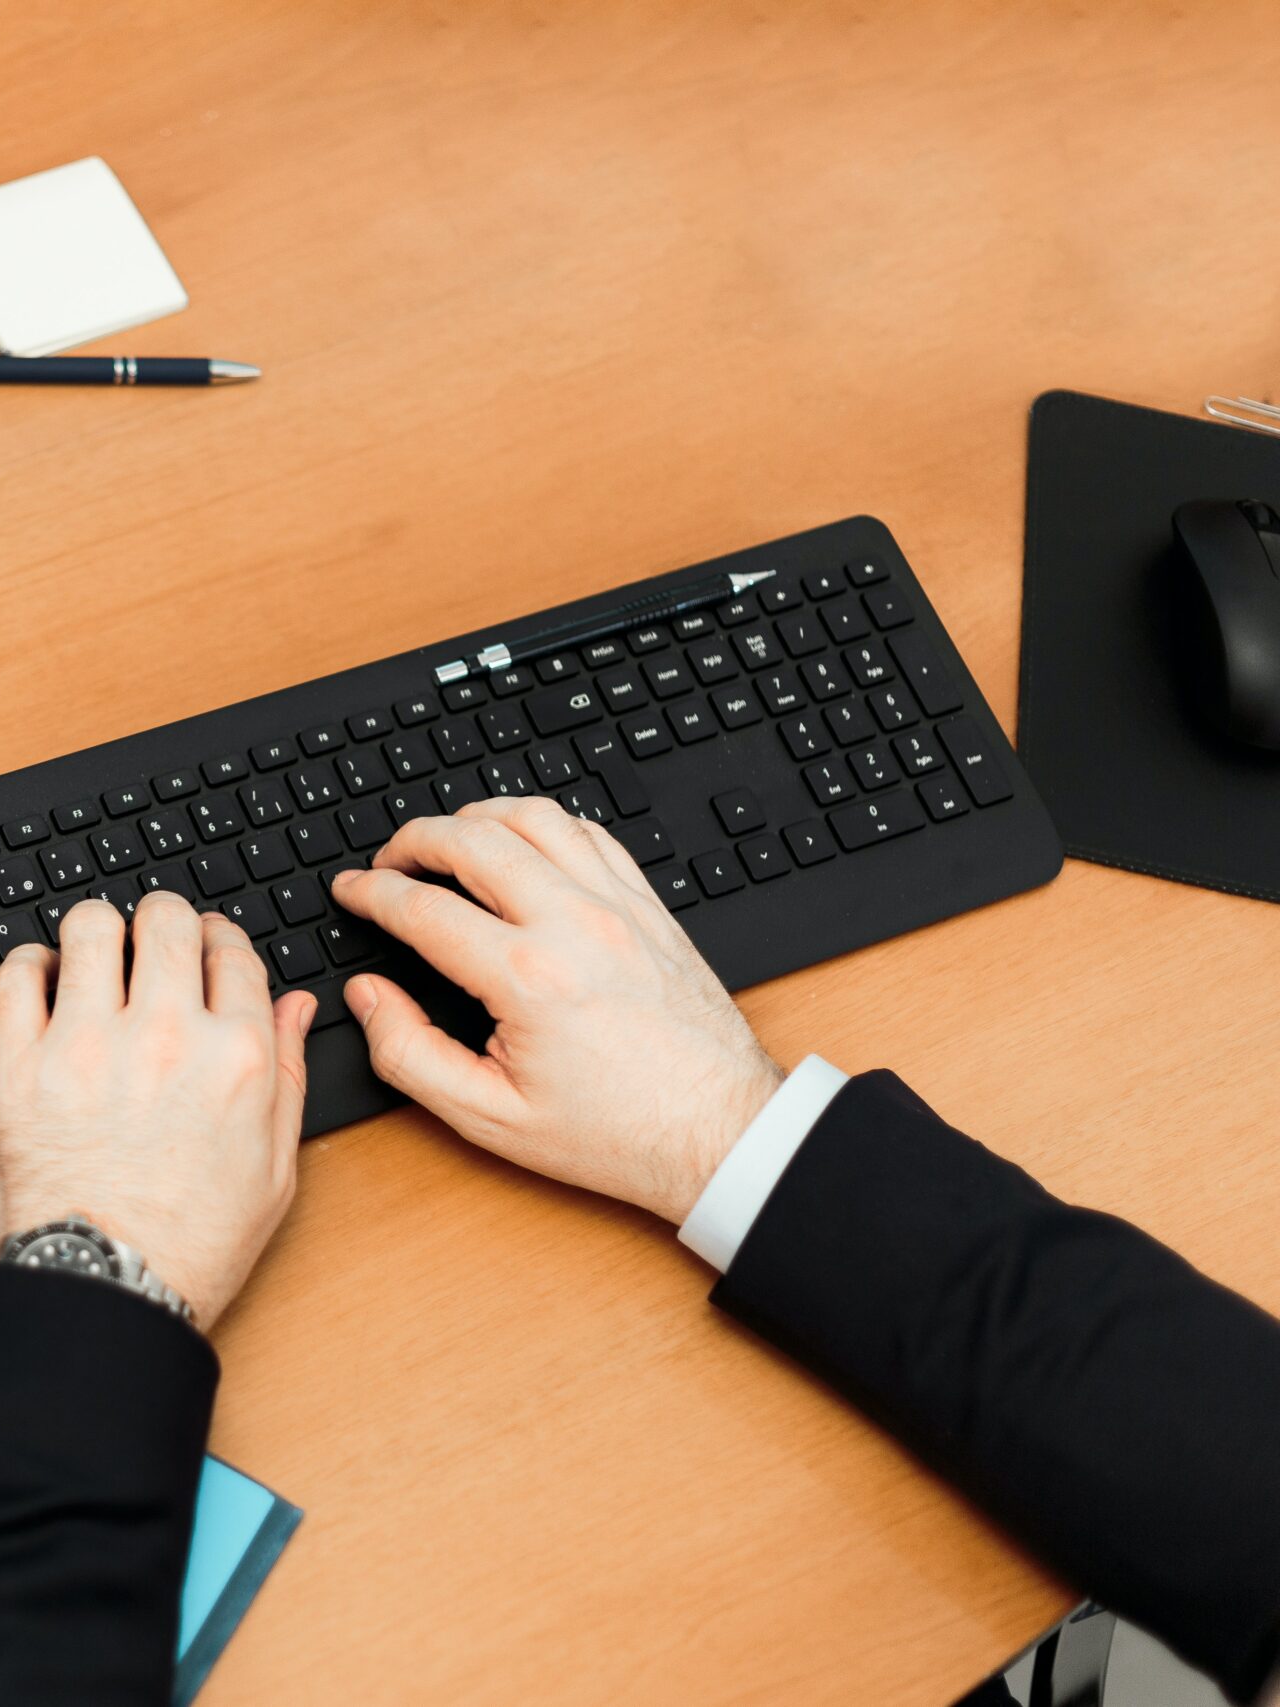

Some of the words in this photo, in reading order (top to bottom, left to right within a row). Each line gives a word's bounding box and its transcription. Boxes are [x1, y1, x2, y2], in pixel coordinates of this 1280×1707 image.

[683, 618, 703, 629] Pause
[592, 646, 614, 658] PrtScn
[862, 650, 870, 661] 9
[703, 655, 722, 667] PgUp
[818, 664, 826, 675] 8
[506, 674, 518, 684] F12
[658, 669, 678, 680] Home
[773, 678, 780, 689] 7
[460, 689, 471, 698] F11
[612, 683, 632, 695] Insert
[887, 694, 895, 705] 6
[412, 703, 425, 713] F10
[727, 700, 746, 711] PgDn
[842, 708, 850, 720] 5
[366, 718, 376, 727] F9
[685, 714, 698, 725] End
[799, 723, 806, 733] 4
[319, 733, 328, 742] F8
[635, 728, 657, 740] Delete
[912, 739, 919, 750] 3
[270, 748, 279, 757] F7
[867, 753, 875, 764] 2
[221, 763, 231, 772] F6
[403, 761, 410, 770] 0
[823, 768, 830, 778] 1
[172, 779, 182, 787] F5
[355, 777, 362, 786] 9
[444, 784, 450, 793] P
[123, 794, 133, 802] F4
[307, 792, 314, 800] 8
[396, 799, 404, 808] O
[73, 809, 83, 818] F3
[201, 806, 209, 815] &
[258, 807, 263, 816] 7
[869, 805, 877, 816] 0
[22, 825, 32, 833] F2
[151, 822, 160, 830] %
[209, 823, 215, 832] 6
[300, 829, 308, 838] U
[160, 838, 166, 847] 5
[251, 845, 259, 854] Z
[110, 854, 116, 862] 4
[201, 861, 207, 869] T
[58, 870, 65, 879] 3
[24, 881, 33, 890] @
[151, 877, 158, 886] R
[673, 879, 686, 889] Ctrl
[8, 886, 14, 895] 2
[283, 890, 291, 899] H
[127, 903, 136, 911] €
[234, 906, 242, 915] G
[49, 908, 58, 917] W
[0, 925, 8, 934] Q
[331, 929, 340, 938] N
[282, 946, 289, 955] B
